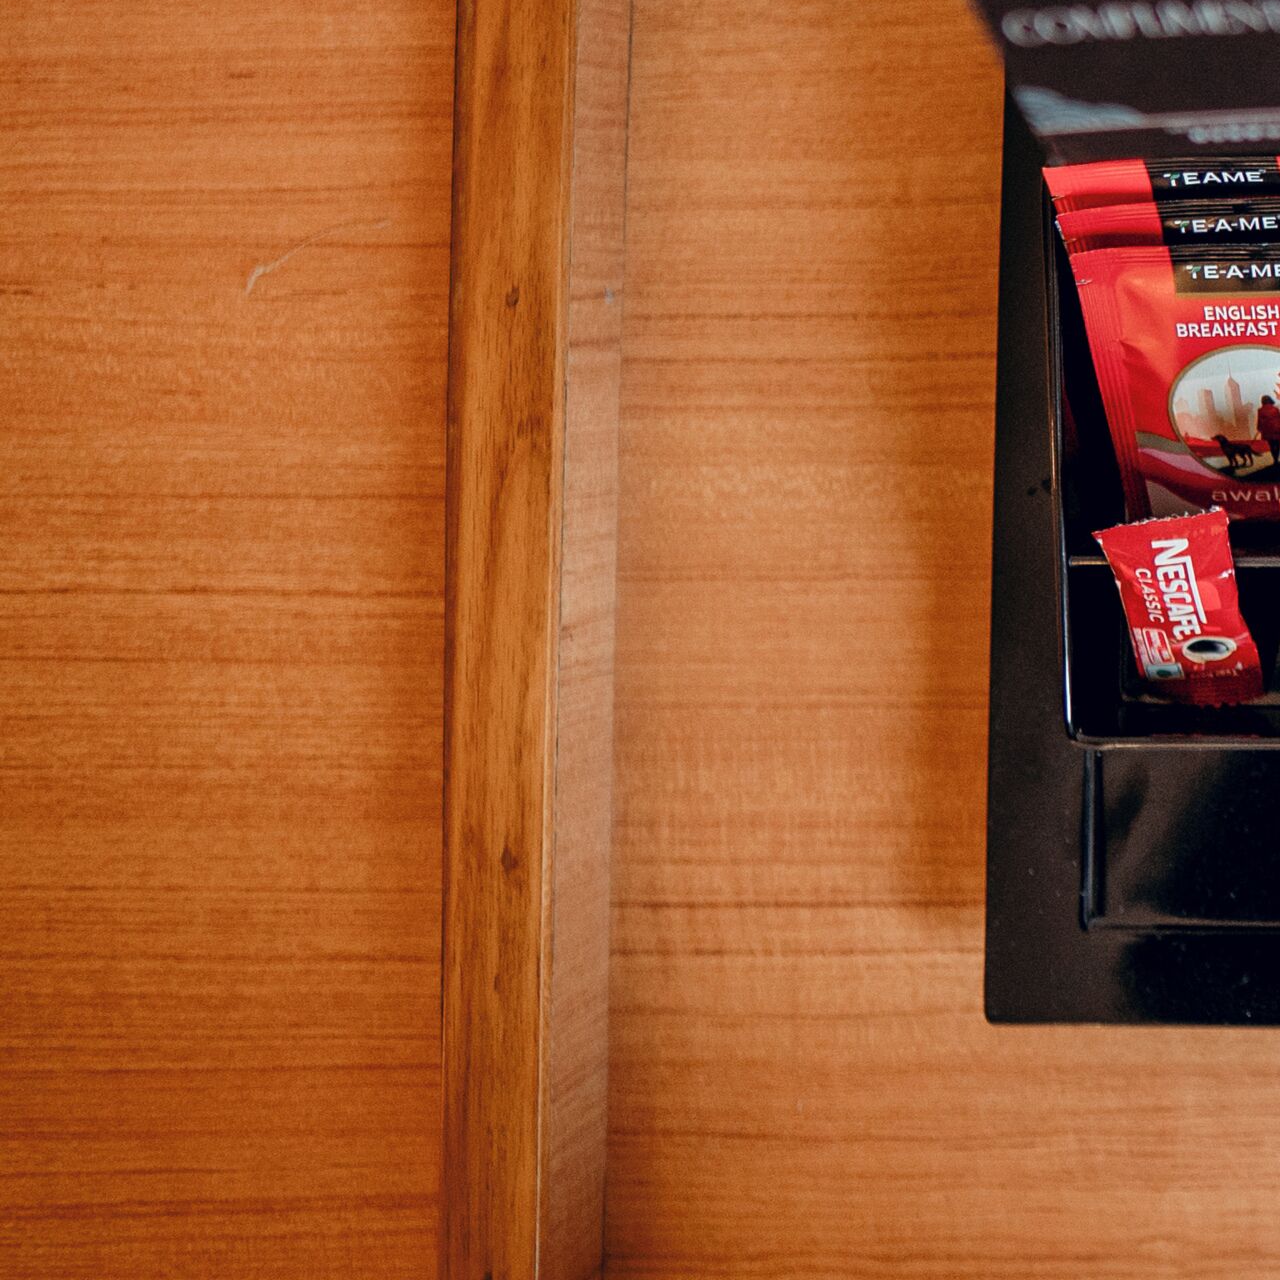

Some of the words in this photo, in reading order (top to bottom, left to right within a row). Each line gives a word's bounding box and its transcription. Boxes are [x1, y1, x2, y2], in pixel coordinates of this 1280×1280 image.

[1174, 216, 1279, 233] TE-A-ME
[1203, 304, 1280, 321] ENGLISH
[1176, 321, 1278, 338] BREAKFAST
[1135, 567, 1165, 624] CLASSIC
